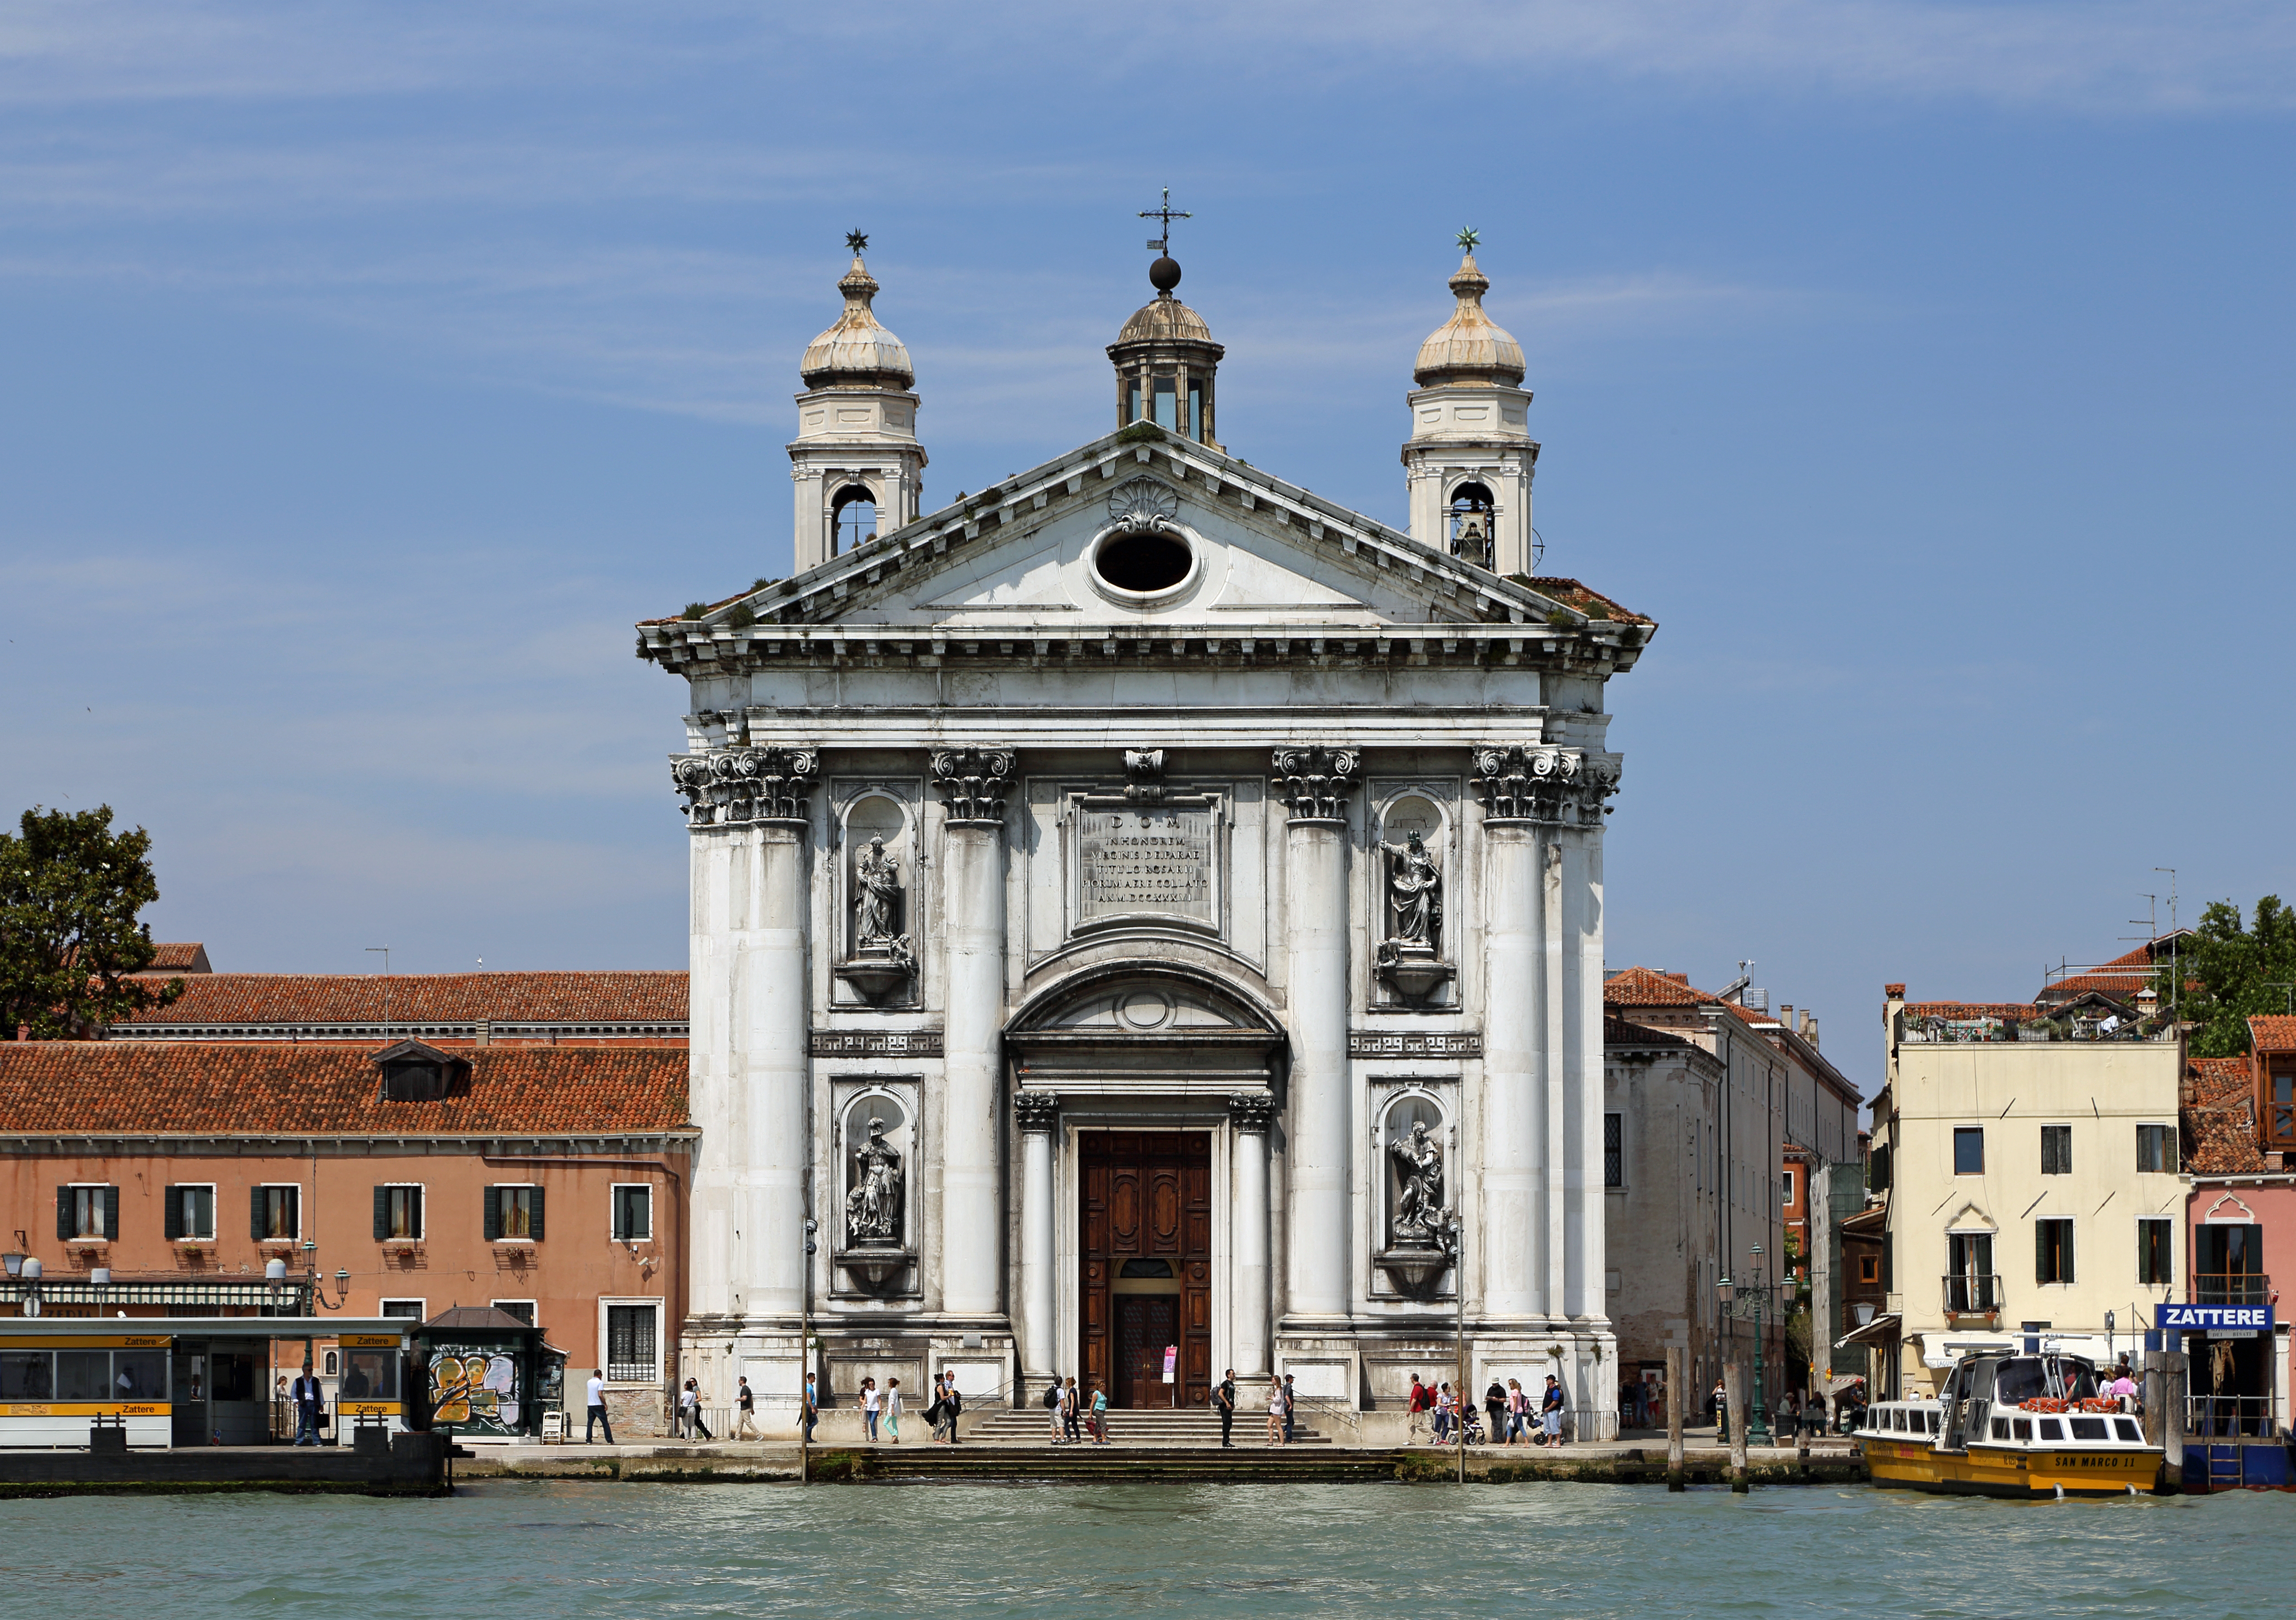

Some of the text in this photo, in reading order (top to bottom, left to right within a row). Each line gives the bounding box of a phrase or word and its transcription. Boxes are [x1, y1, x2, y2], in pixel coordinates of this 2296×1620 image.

[2166, 1309, 2266, 1325] ZATTERE
[357, 1337, 389, 1345] Zattere
[356, 1404, 387, 1413] Zattere
[1876, 1440, 1895, 1458] Hilton
[2055, 1457, 2135, 1467] SAN MARCO 11
